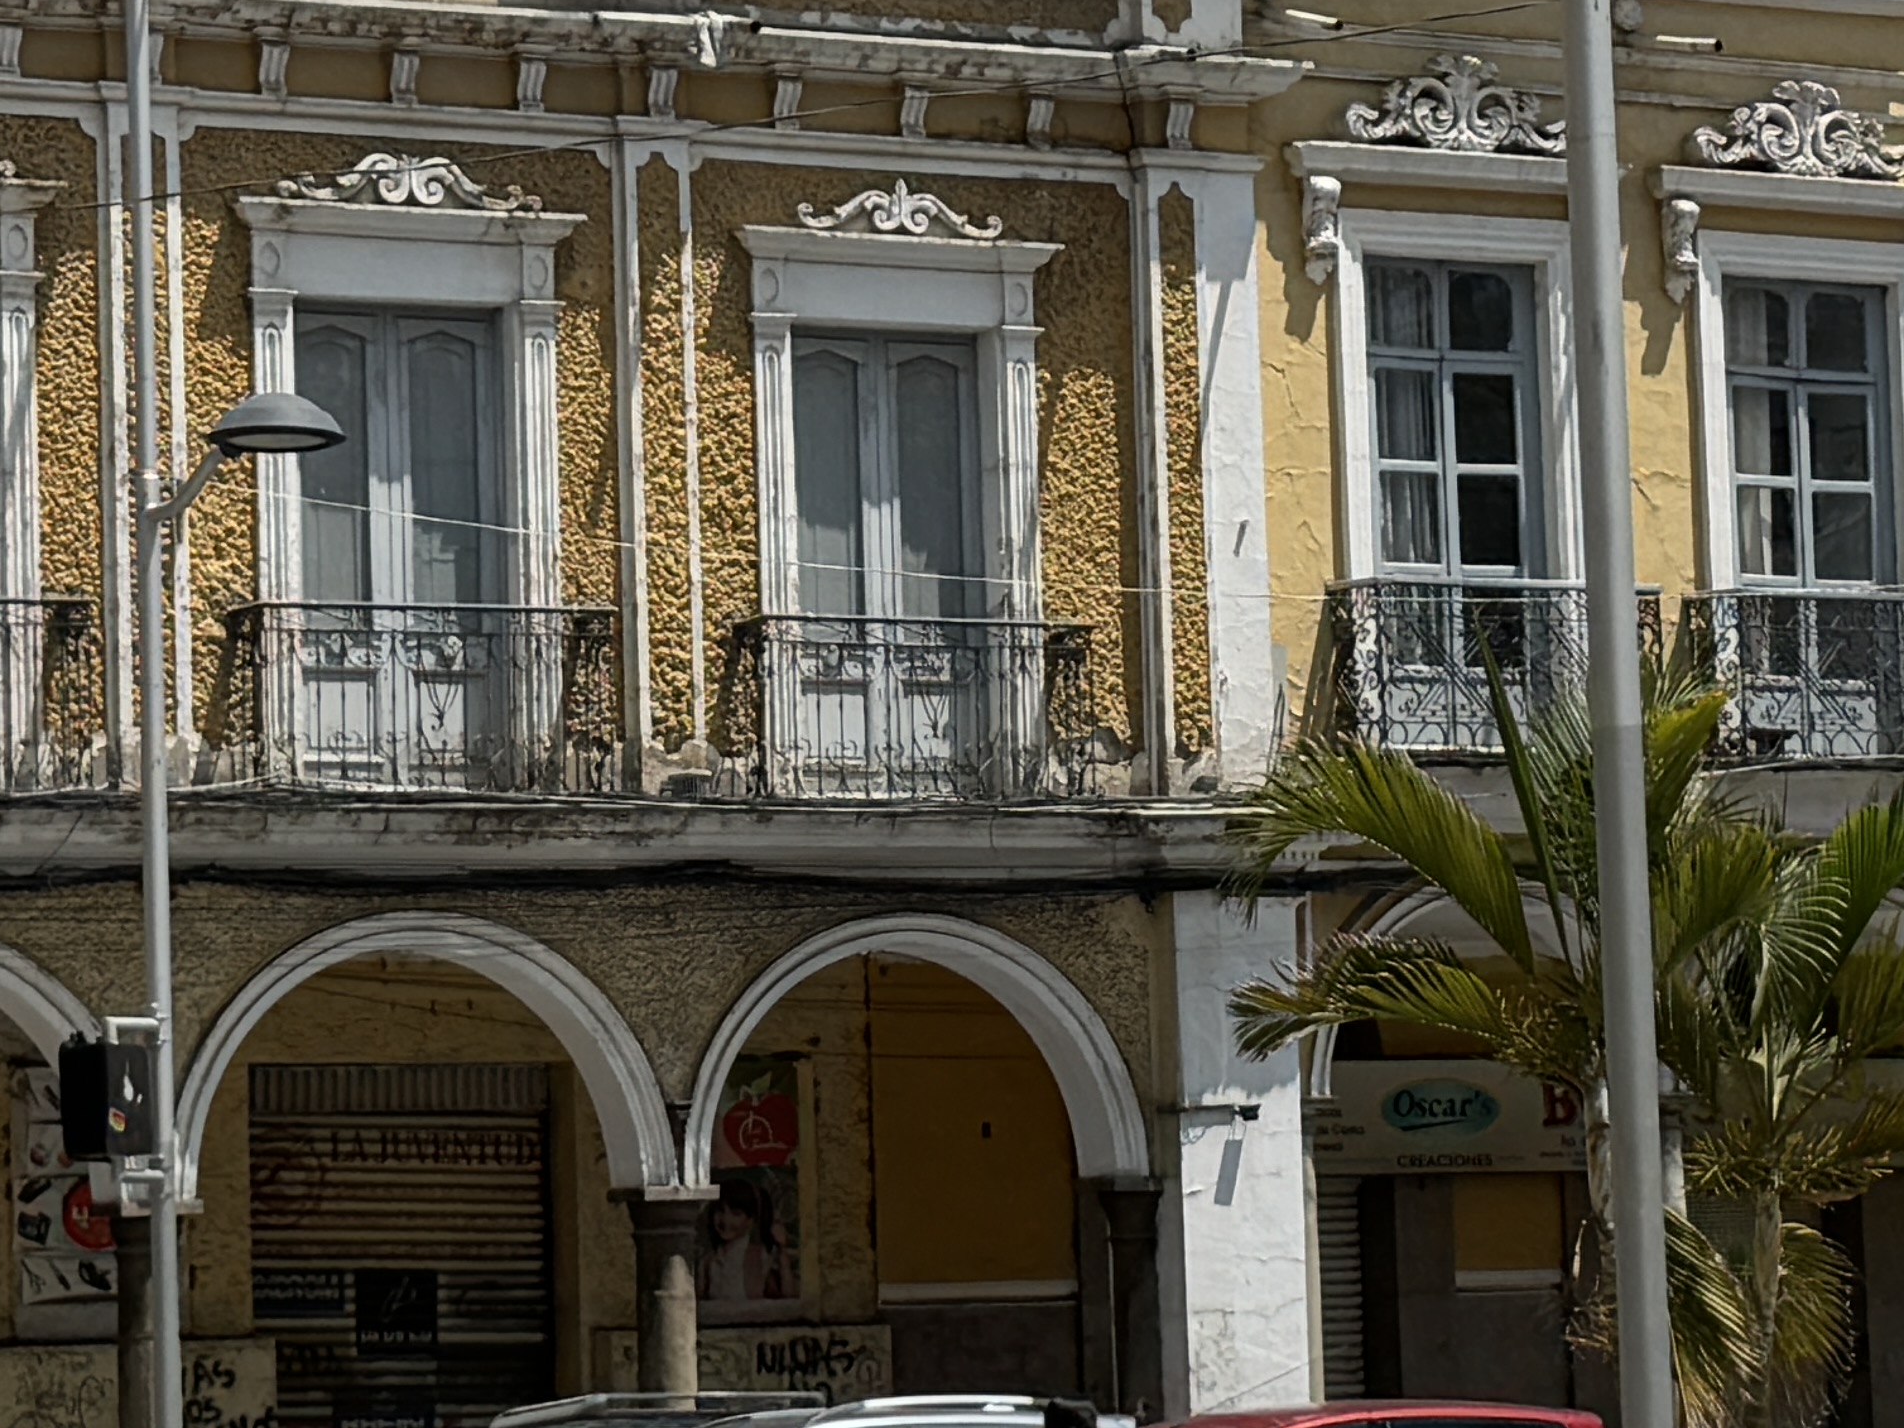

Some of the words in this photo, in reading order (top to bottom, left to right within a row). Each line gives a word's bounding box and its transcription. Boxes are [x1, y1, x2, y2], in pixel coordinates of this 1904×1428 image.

[1392, 1088, 1493, 1118] Oscar's
[330, 1130, 368, 1163] LA
[380, 1130, 539, 1165] JUVENTUD
[1396, 1153, 1494, 1168] CREACIONES
